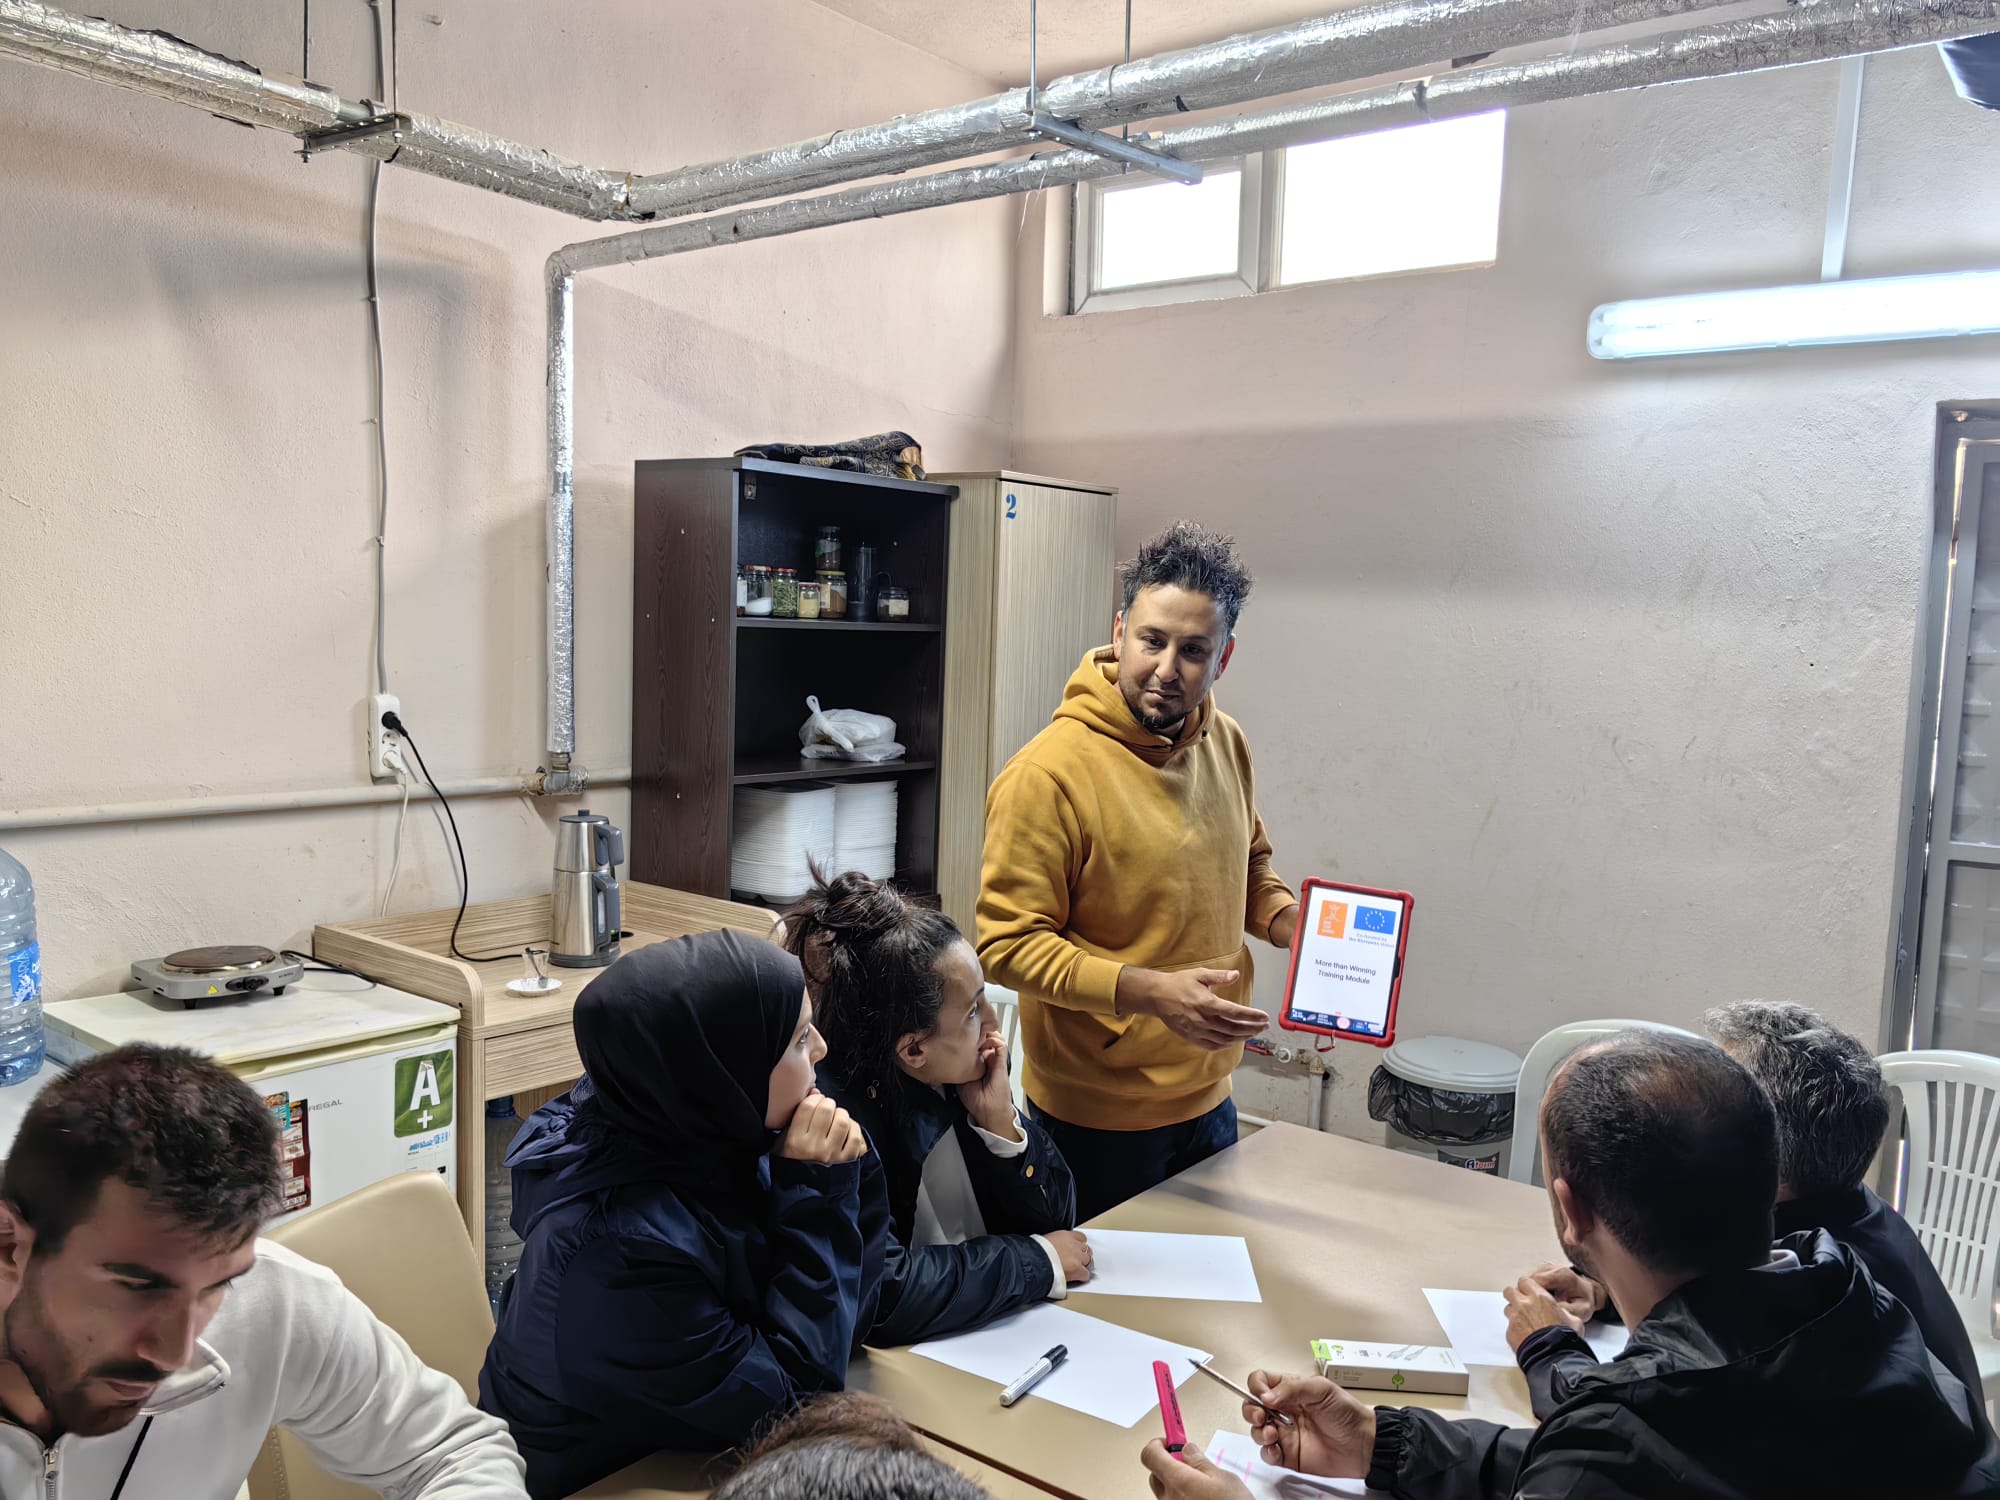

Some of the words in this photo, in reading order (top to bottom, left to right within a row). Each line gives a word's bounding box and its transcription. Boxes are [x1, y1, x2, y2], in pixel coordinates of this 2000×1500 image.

[1005, 494, 1017, 519] 2
[1315, 959, 1332, 968] More
[1333, 962, 1348, 970] than
[1349, 964, 1376, 976] Winning
[1318, 969, 1344, 981] Training
[1345, 974, 1371, 984] Module
[308, 1099, 343, 1113] REGAL
